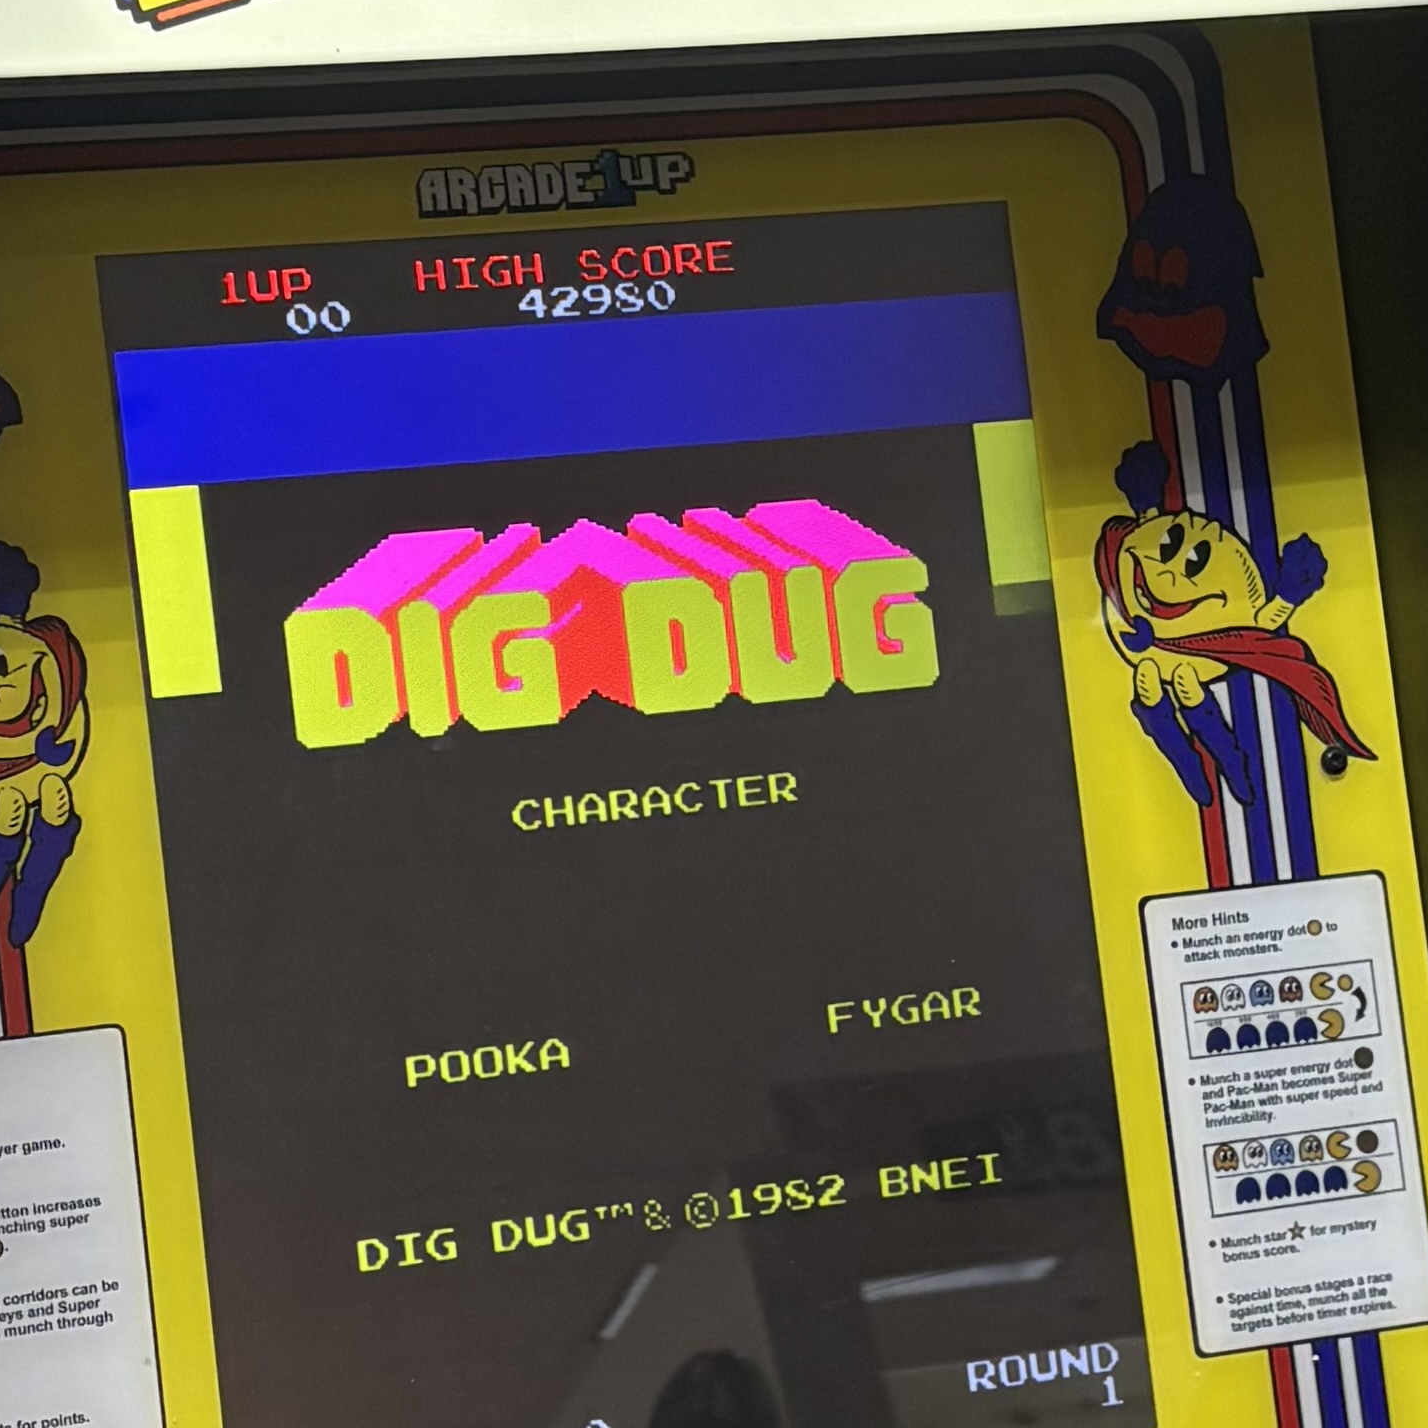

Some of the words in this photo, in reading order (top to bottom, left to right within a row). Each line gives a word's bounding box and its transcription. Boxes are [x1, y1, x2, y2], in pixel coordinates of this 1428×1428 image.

[219, 265, 314, 307] 1UP
[414, 250, 547, 293] HIGH
[577, 239, 736, 281] SCORE
[285, 298, 352, 336] 00
[517, 279, 678, 320] 42980
[283, 577, 565, 750] DIG
[621, 547, 940, 717] DUG
[511, 771, 800, 832] CHARACTER
[1171, 915, 1209, 932] More
[1211, 910, 1251, 927] Hints
[1181, 935, 1224, 951] Munch
[1222, 942, 1284, 959] monsters.
[826, 986, 983, 1035] FYGAR
[405, 1037, 573, 1089] POOKA
[1199, 1072, 1242, 1088] Munch
[1281, 1073, 1336, 1091] becomes
[21, 1136, 67, 1157] game.
[31, 1195, 103, 1215] increases
[356, 1226, 459, 1274] DIG
[878, 1151, 1004, 1200] BNEI
[48, 1211, 91, 1230] super
[1220, 1233, 1262, 1250] Munch
[1222, 1248, 1261, 1264] bonus
[2, 1286, 70, 1308] corridors
[71, 1282, 99, 1299] can
[1227, 1288, 1272, 1306] Special
[1273, 1281, 1313, 1298] bonus
[26, 1304, 55, 1320] and
[57, 1297, 103, 1317] Super
[1229, 1302, 1274, 1320] against
[3, 1319, 55, 1338] munch
[56, 1309, 115, 1331] through
[1230, 1316, 1274, 1334] targets
[966, 1341, 1121, 1394] ROUND
[1100, 1376, 1125, 1408] 1
